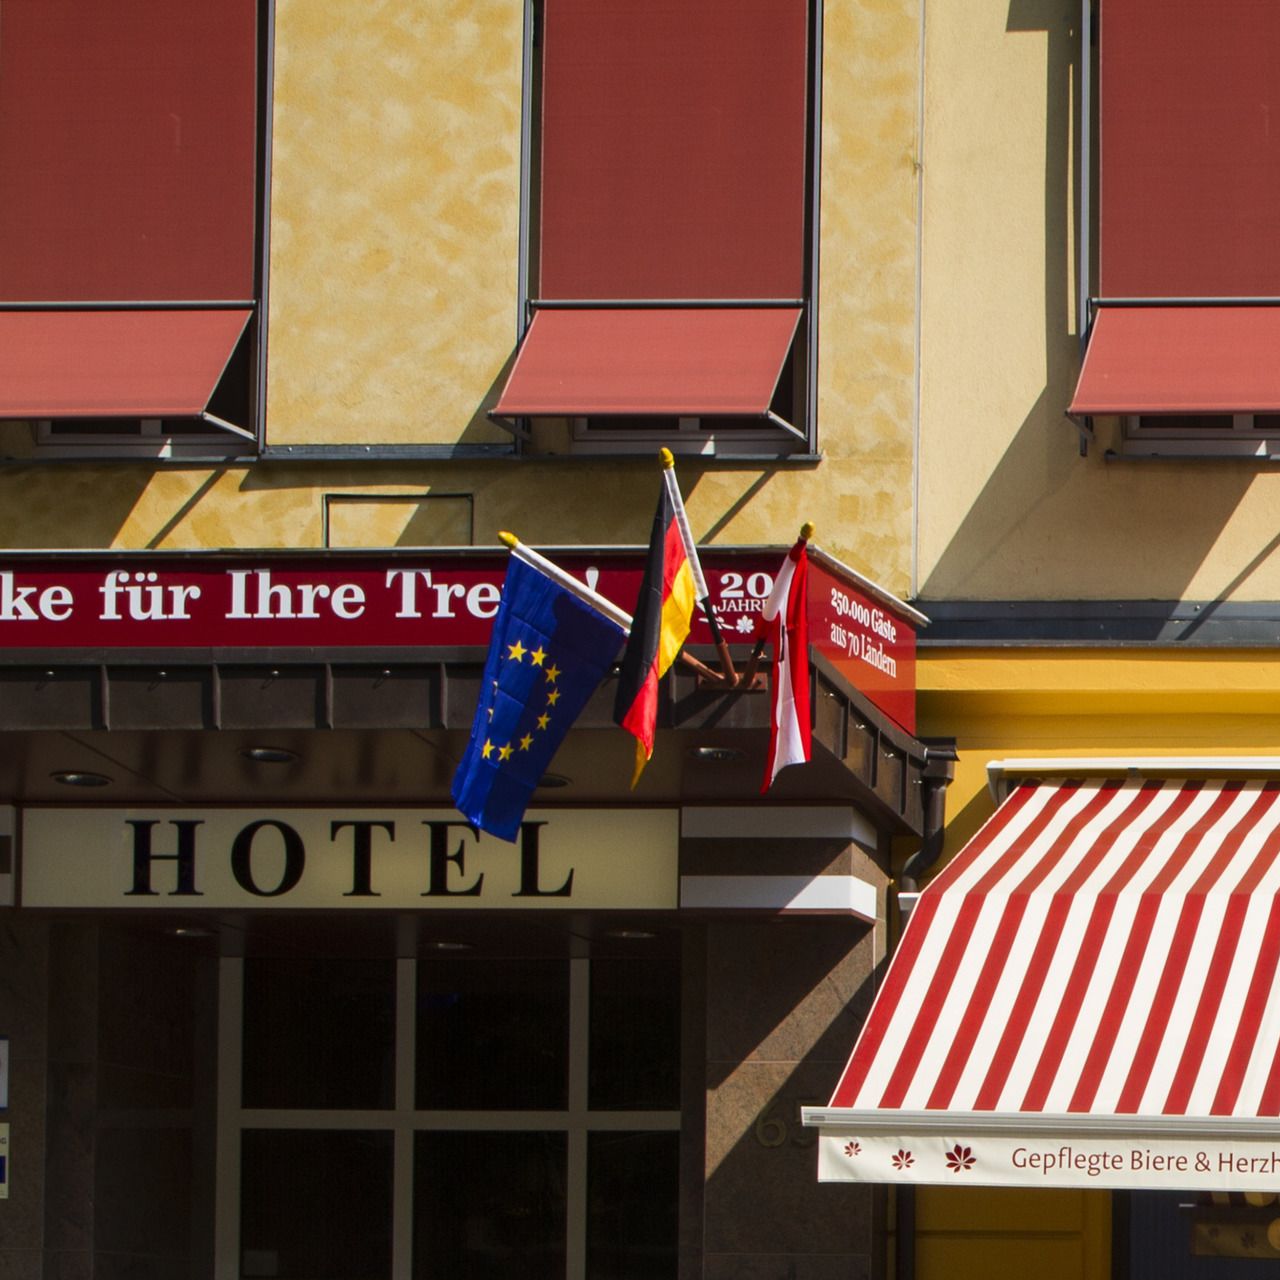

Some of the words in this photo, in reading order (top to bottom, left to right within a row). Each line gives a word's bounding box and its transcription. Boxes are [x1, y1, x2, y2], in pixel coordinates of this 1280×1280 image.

[98, 570, 201, 621] für
[226, 571, 366, 619] Ihre
[719, 572, 774, 599] 20
[831, 587, 870, 628] 250.000
[871, 607, 897, 644] Gäste
[830, 622, 847, 649] aus
[848, 631, 860, 658] 70
[861, 633, 897, 679] Ländern
[123, 818, 574, 897] HOTEL
[1011, 1146, 1124, 1176] Gepflegte
[1130, 1149, 1188, 1172] Biere
[1194, 1151, 1212, 1172] &
